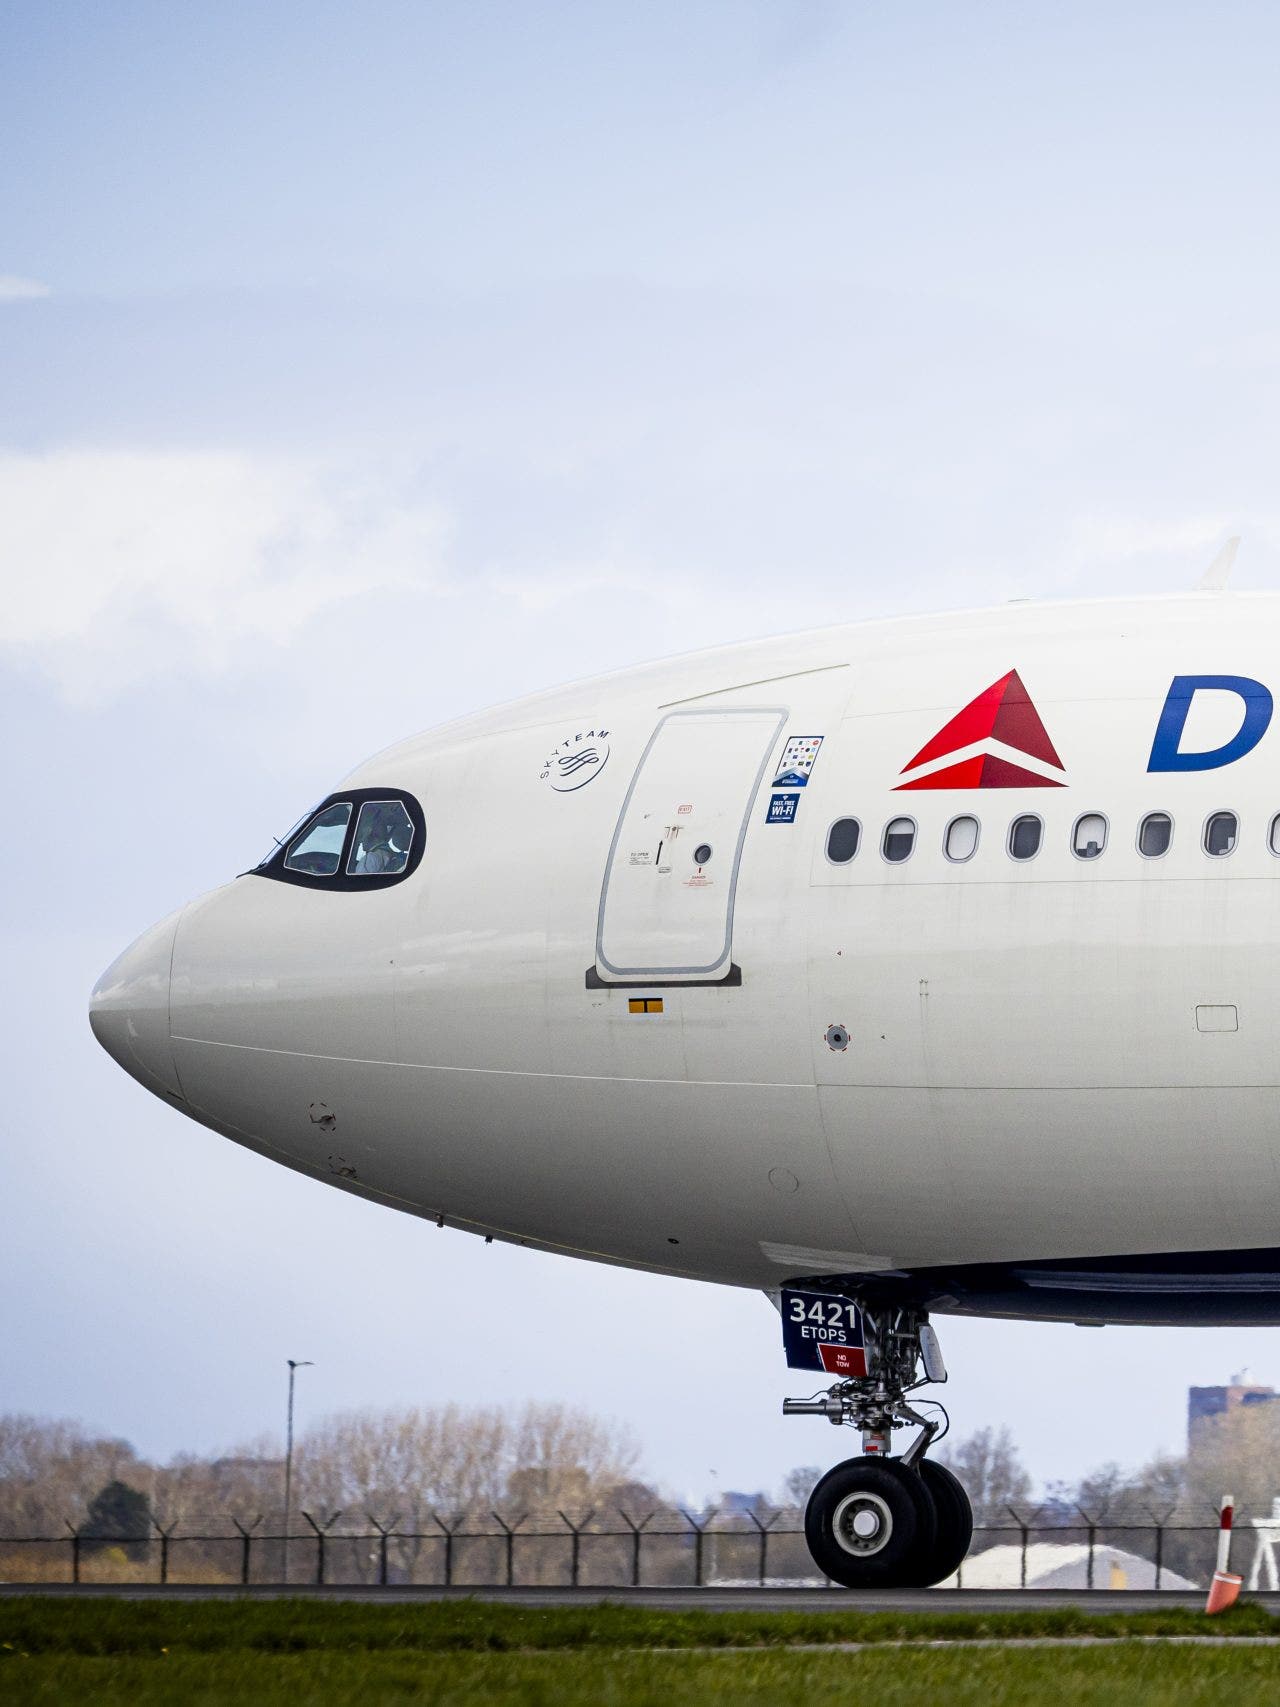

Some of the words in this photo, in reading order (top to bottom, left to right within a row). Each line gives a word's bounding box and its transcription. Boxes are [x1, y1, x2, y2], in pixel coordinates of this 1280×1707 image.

[540, 730, 609, 779] SKYTEAM
[771, 806, 794, 816] WI-FI
[789, 1298, 856, 1329] 3421
[801, 1325, 847, 1342] ETOPS
